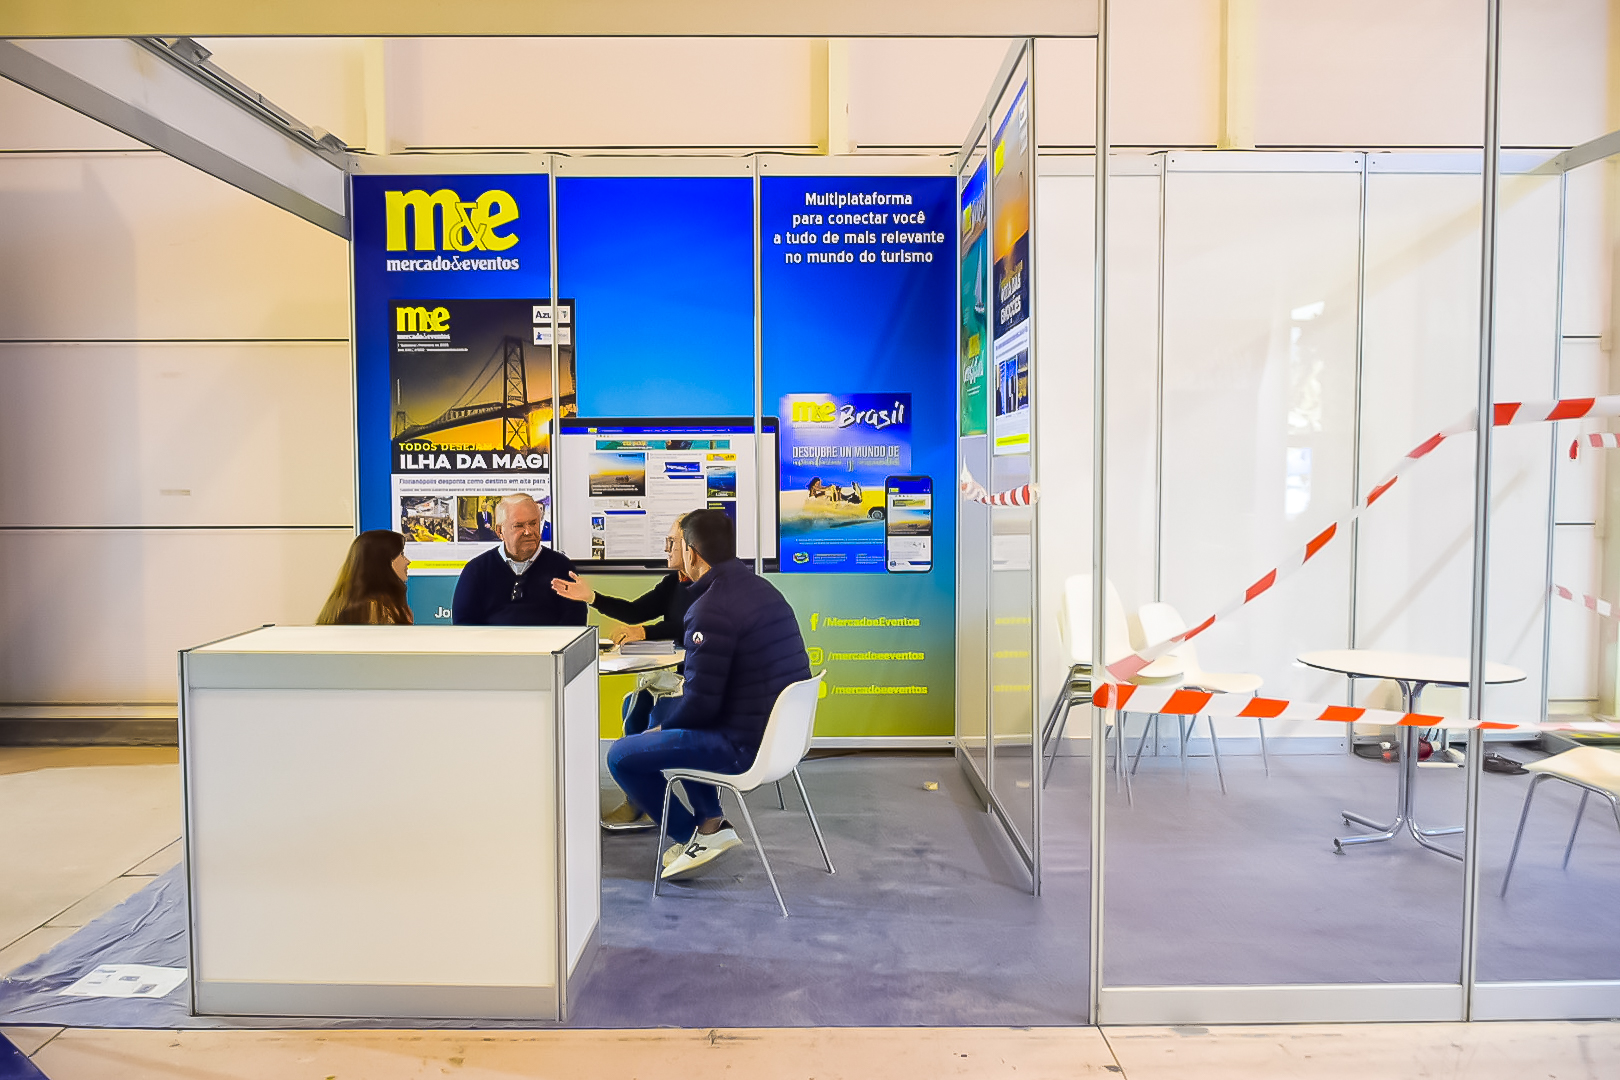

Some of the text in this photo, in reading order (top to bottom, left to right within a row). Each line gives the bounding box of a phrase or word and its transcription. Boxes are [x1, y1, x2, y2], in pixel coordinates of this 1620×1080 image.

[805, 192, 913, 208] Multiplataforma
[385, 189, 519, 251] m&e
[792, 210, 926, 228] para conectar você
[773, 230, 945, 244] a tudo de mais relevante
[386, 255, 520, 271] mercado&eventos
[785, 249, 933, 263] no mundo do turismo
[396, 306, 450, 332] m&e
[535, 310, 551, 319] Azu
[792, 401, 836, 423] m&e
[838, 401, 905, 430] Brasil
[399, 442, 437, 451] TODOS
[792, 445, 900, 458] DESCUBRE UN MUNDO DE
[400, 453, 549, 469] ILHA DA MAGI
[434, 606, 453, 619] Jo
